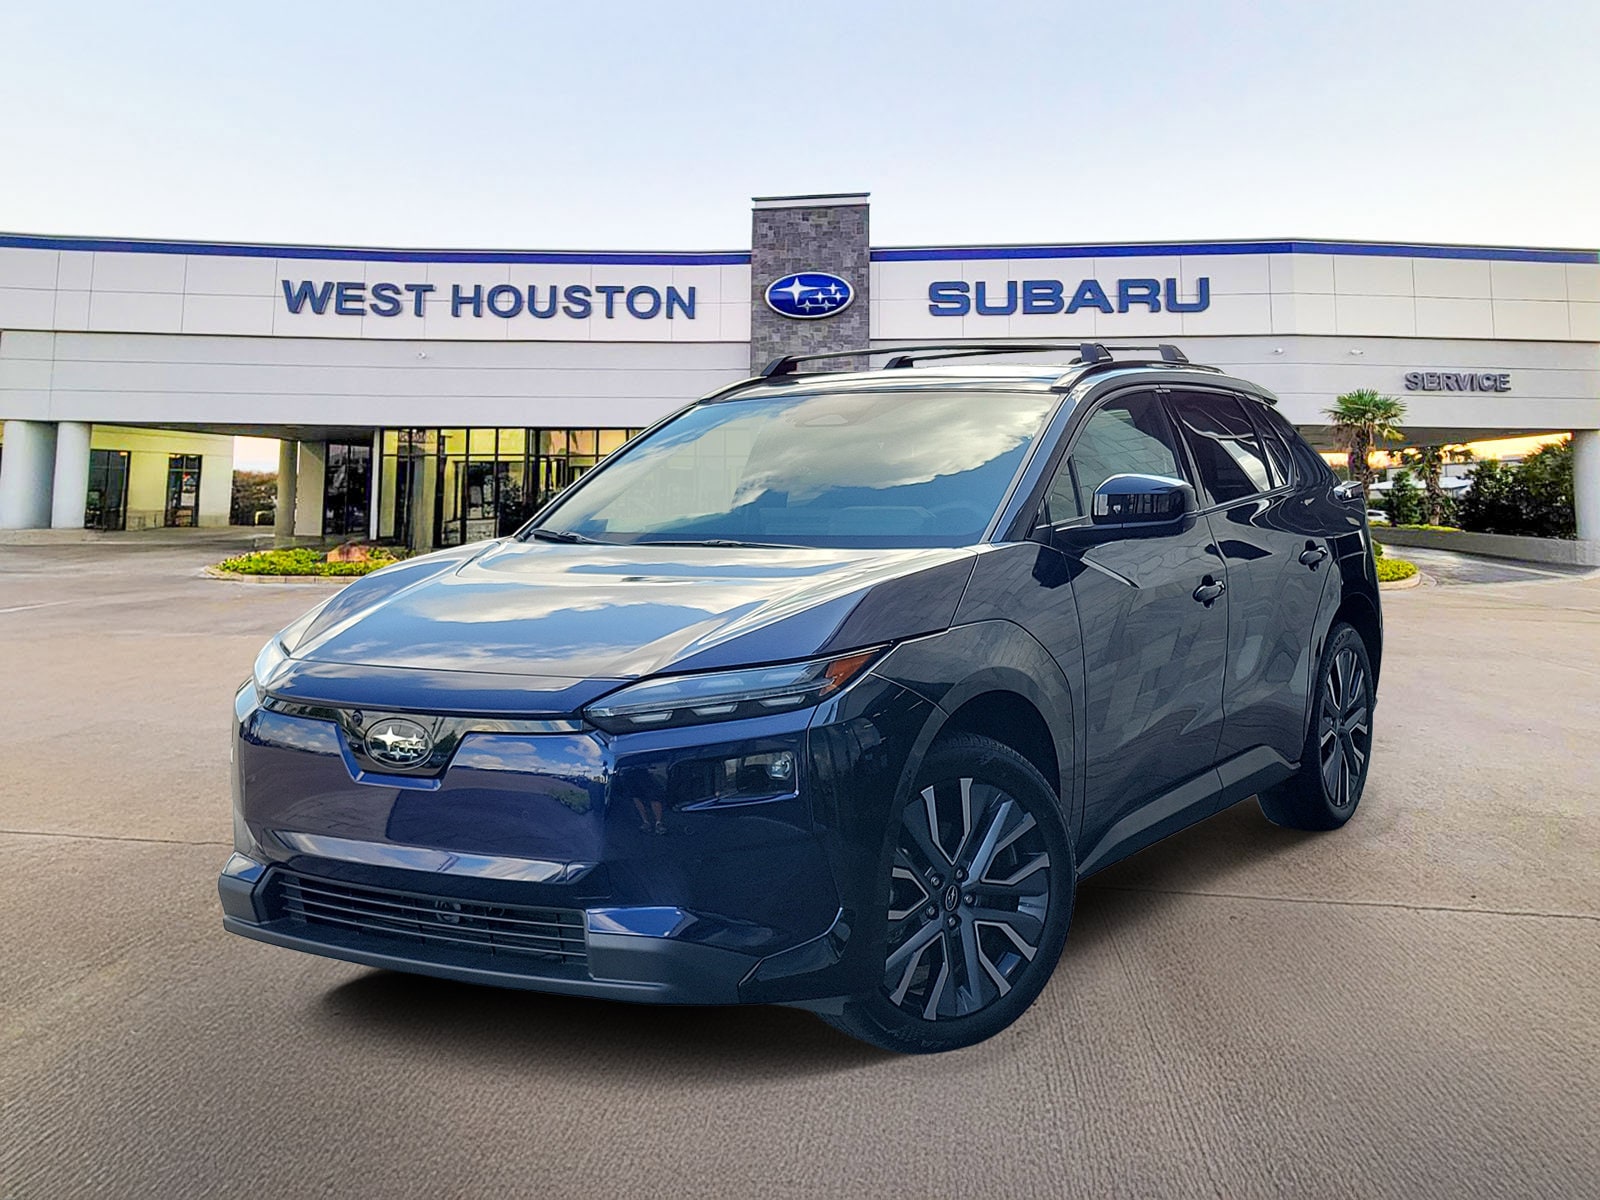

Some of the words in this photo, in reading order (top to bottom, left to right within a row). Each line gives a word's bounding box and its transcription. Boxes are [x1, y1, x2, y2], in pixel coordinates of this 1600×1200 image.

[282, 279, 436, 317] WEST
[451, 284, 696, 319] HOUSTON
[929, 277, 1210, 316] SUBARU
[1405, 372, 1511, 392] SERVICE
